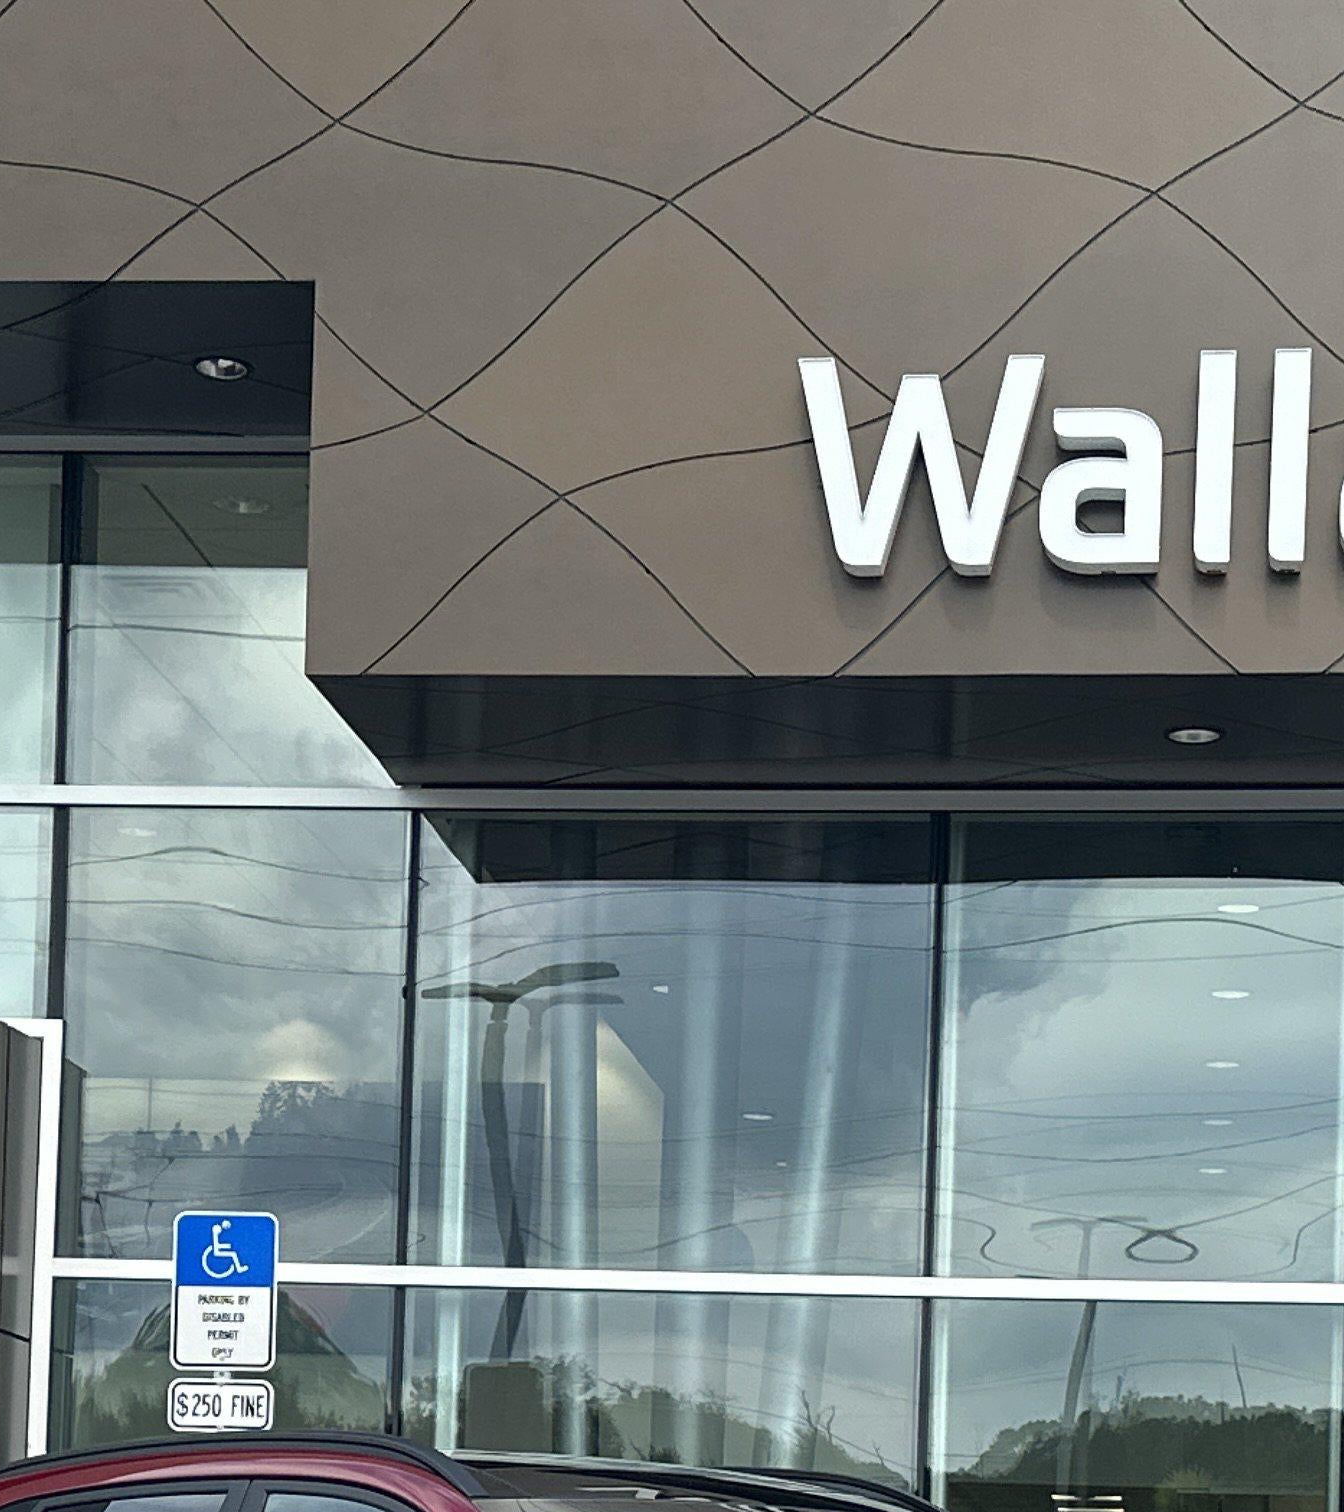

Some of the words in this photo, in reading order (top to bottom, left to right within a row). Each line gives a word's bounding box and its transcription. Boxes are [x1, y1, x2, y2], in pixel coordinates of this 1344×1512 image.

[238, 1295, 250, 1305] BY
[176, 1392, 222, 1419] $250
[231, 1394, 265, 1418] FINE
